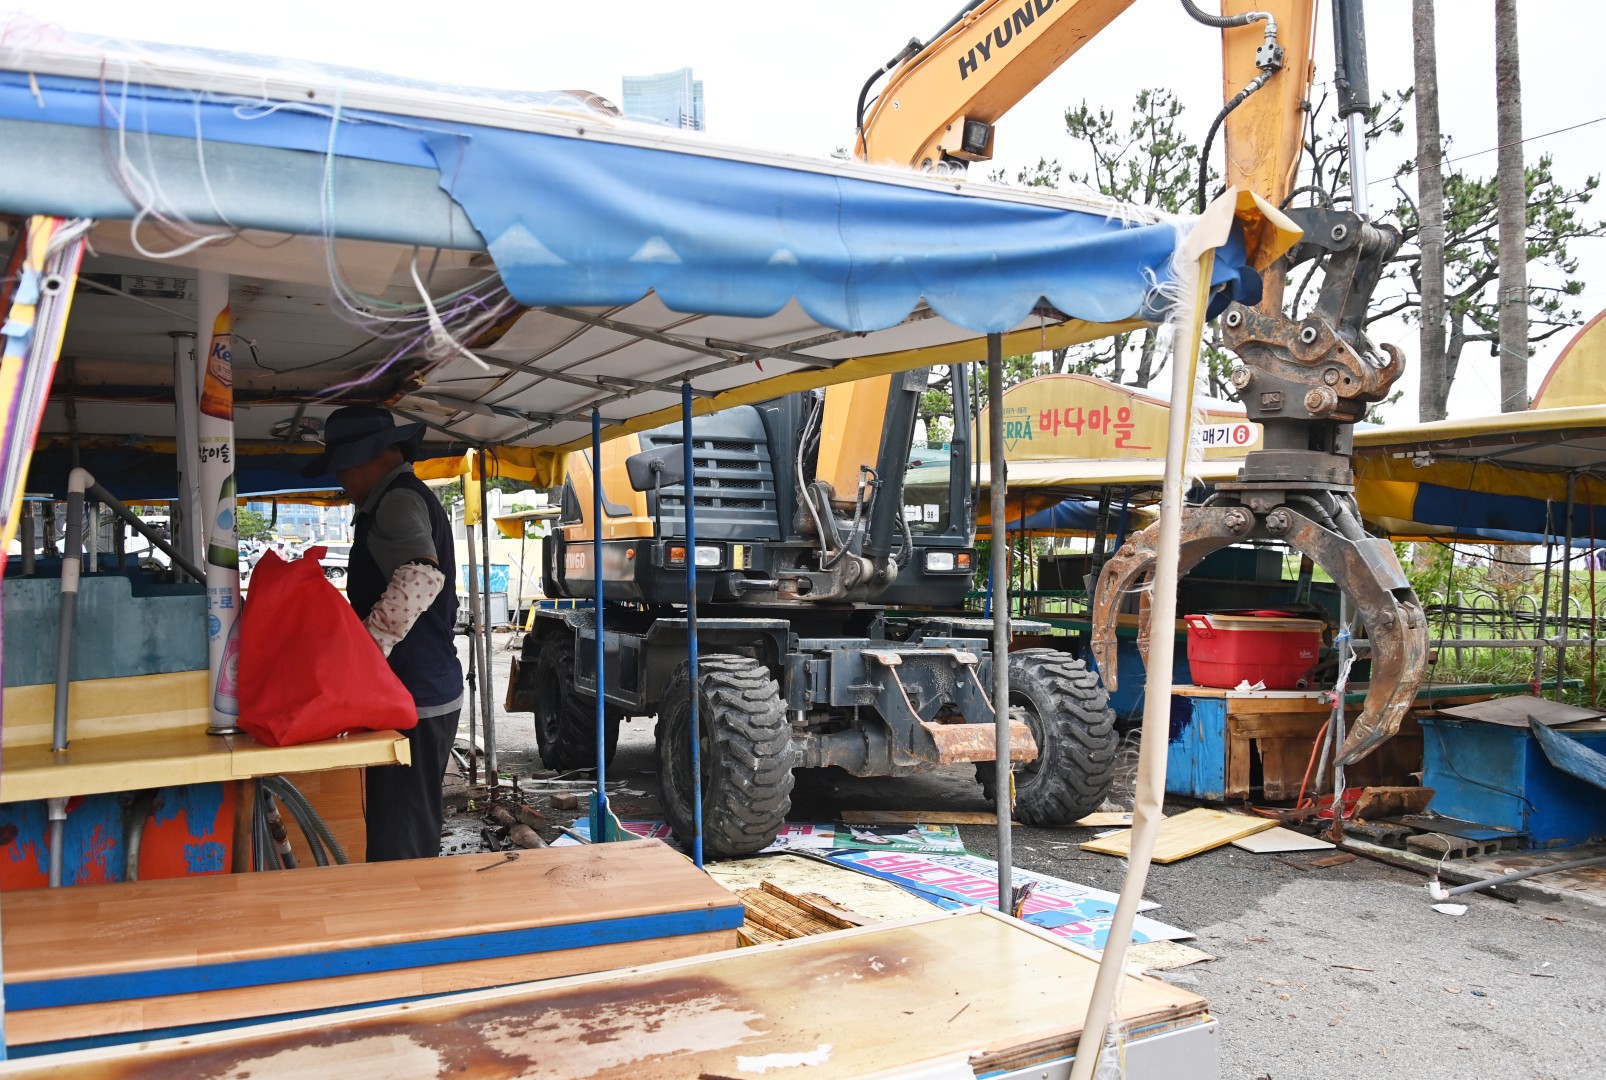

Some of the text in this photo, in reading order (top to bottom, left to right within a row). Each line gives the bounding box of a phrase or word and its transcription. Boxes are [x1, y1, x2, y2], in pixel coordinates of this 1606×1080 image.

[957, 0, 1060, 81] HYUND
[1039, 406, 1152, 449] 바다마을
[1201, 427, 1230, 444] 매기
